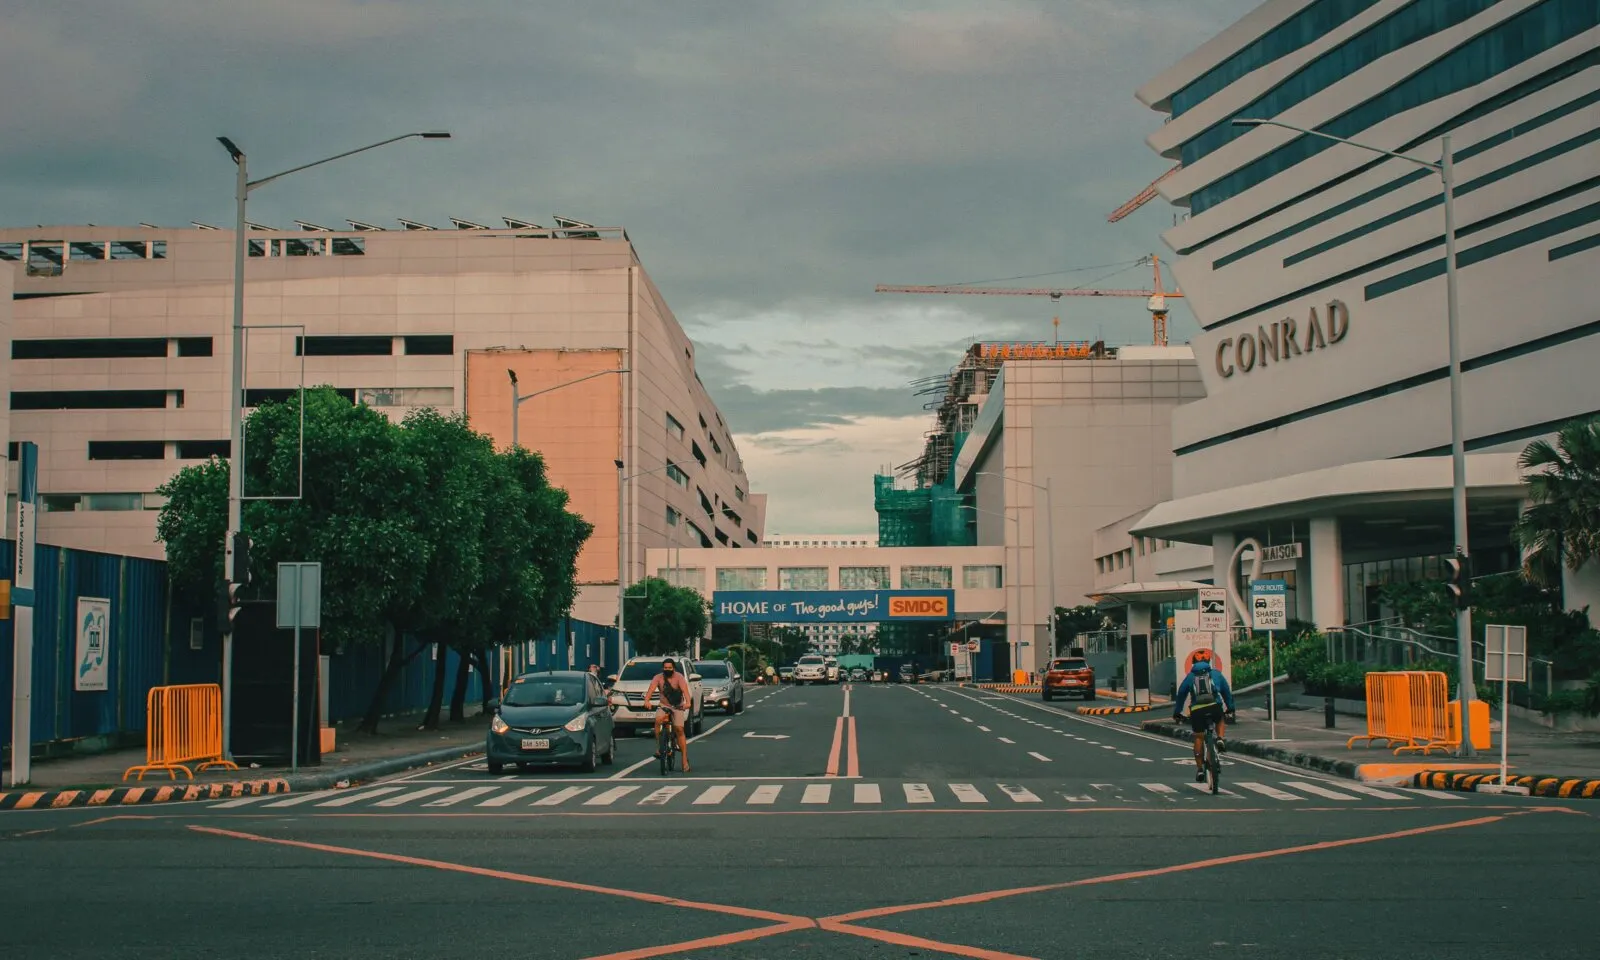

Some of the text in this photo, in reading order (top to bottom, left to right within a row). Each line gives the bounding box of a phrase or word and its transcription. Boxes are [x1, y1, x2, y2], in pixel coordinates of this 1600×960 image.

[1215, 299, 1349, 378] CONRAD
[1262, 544, 1297, 561] MAISON
[721, 594, 944, 619] HOME OF The good guys! SMDC
